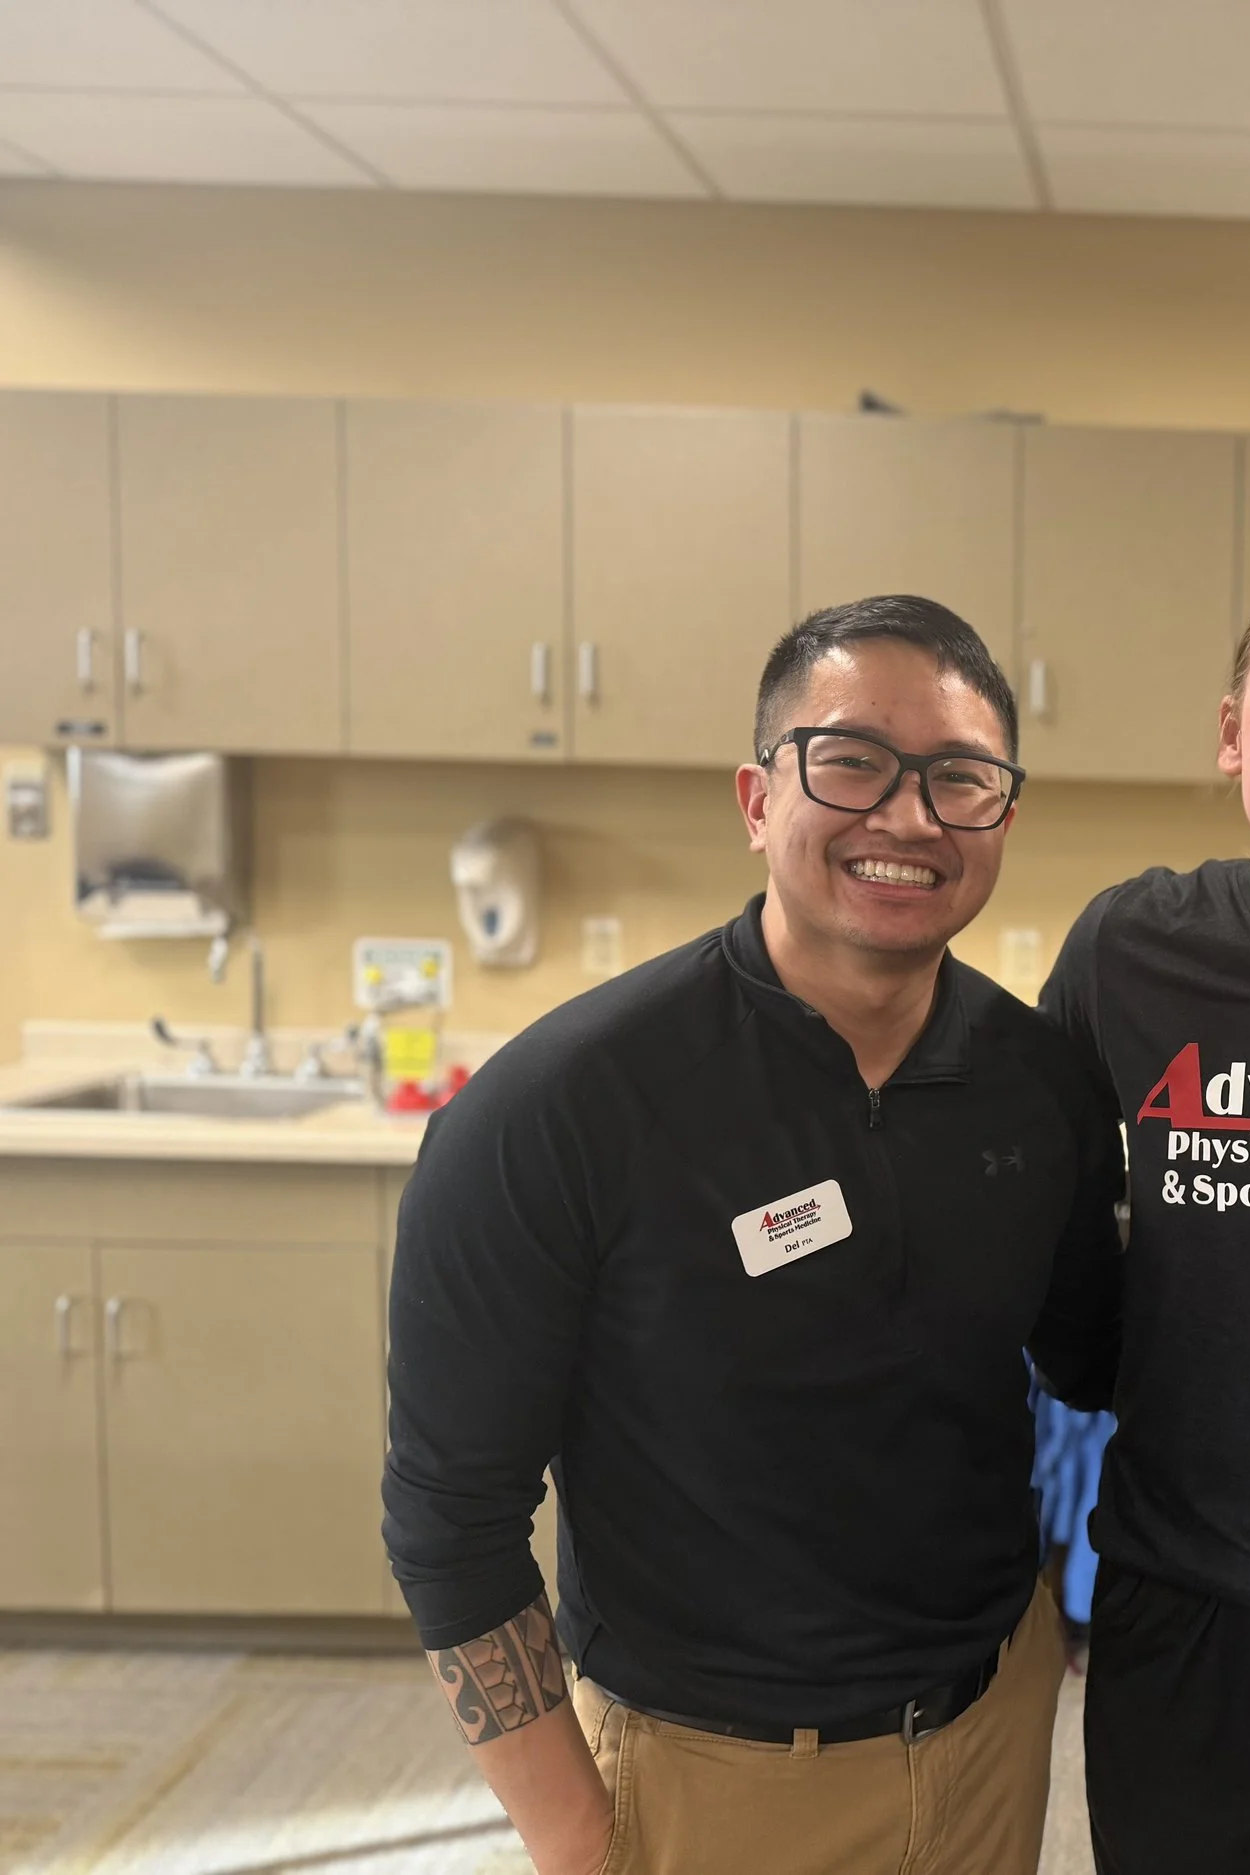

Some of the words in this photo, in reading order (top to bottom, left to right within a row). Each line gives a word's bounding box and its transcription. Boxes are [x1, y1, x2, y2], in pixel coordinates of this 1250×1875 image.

[760, 1198, 816, 1231] Advanced
[767, 1220, 792, 1234] Physical
[793, 1211, 816, 1224] Therapy
[795, 1216, 821, 1230] Medicine
[784, 1240, 800, 1253] Del
